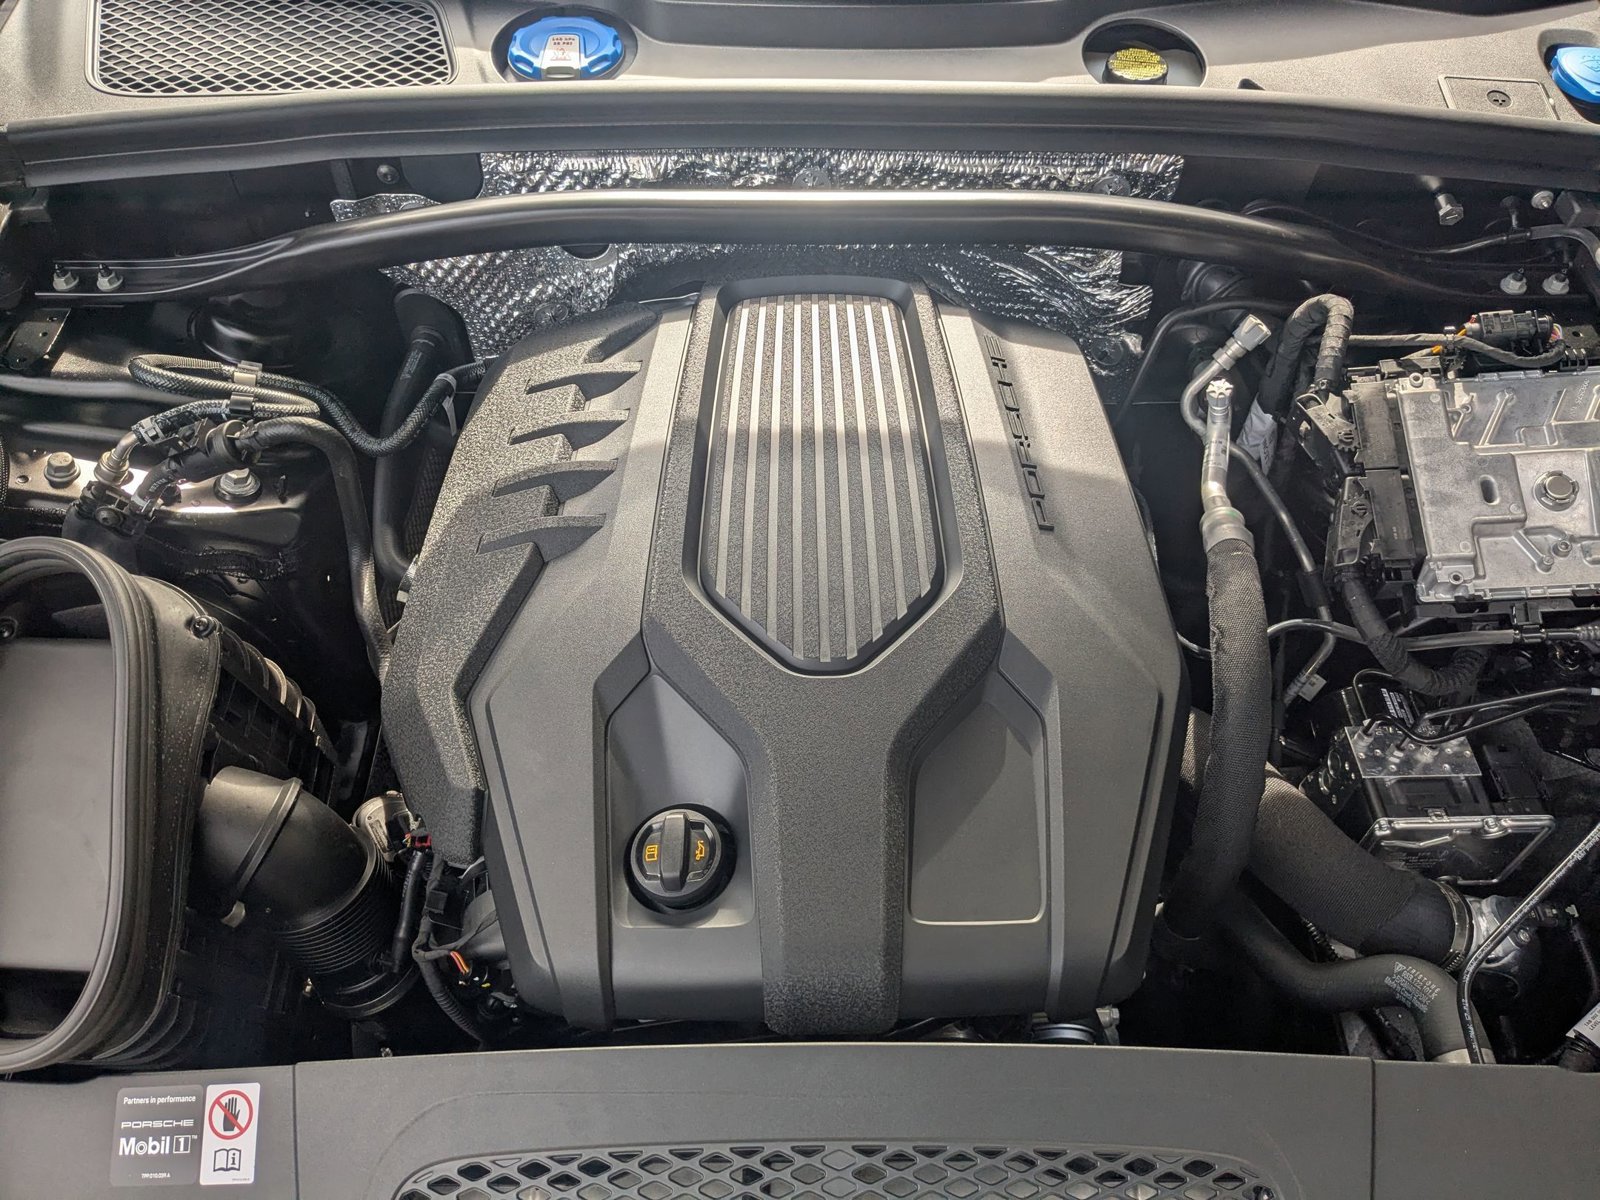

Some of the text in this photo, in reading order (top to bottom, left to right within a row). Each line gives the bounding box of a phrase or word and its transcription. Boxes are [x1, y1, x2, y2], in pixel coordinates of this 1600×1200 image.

[983, 335, 1055, 531] PORSCHE
[1406, 966, 1441, 994] TRISTONE
[123, 1095, 196, 1105] Partners in performance
[121, 1119, 195, 1129] PORSCHE
[119, 1136, 171, 1156] Mobil
